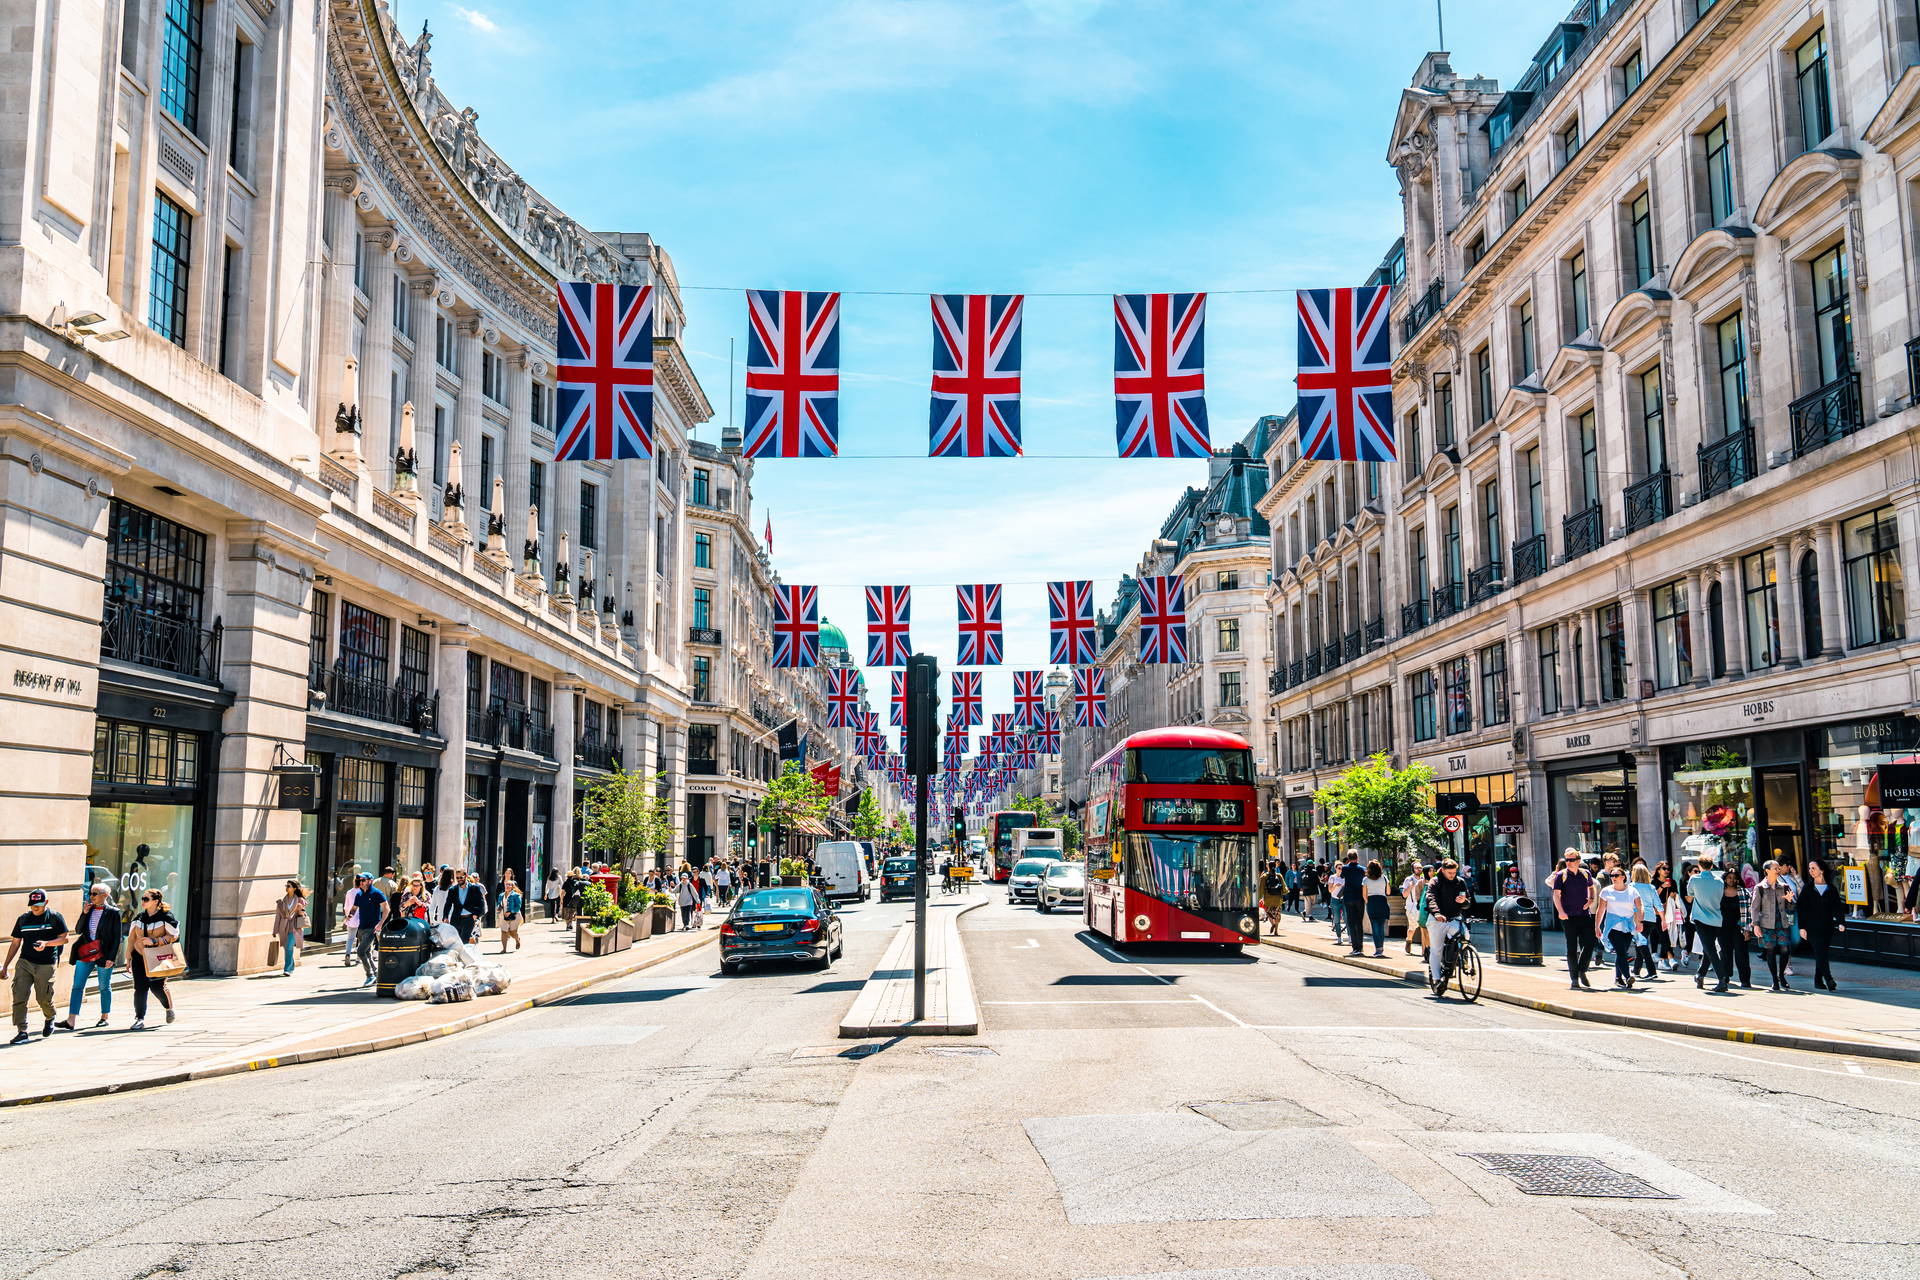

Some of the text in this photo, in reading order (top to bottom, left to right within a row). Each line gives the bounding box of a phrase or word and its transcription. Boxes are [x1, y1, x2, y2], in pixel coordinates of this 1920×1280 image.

[153, 707, 167, 718] 222
[1743, 701, 1774, 716] HOBBS
[1853, 722, 1892, 739] HOBBS
[1566, 734, 1591, 748] BARKER
[1700, 744, 1727, 758] HOBBS
[282, 786, 310, 796] COS
[1884, 788, 1920, 797] HOBBS
[1152, 803, 1236, 819] Marylebone 453
[121, 872, 147, 891] COS
[1849, 874, 1861, 882] 15%
